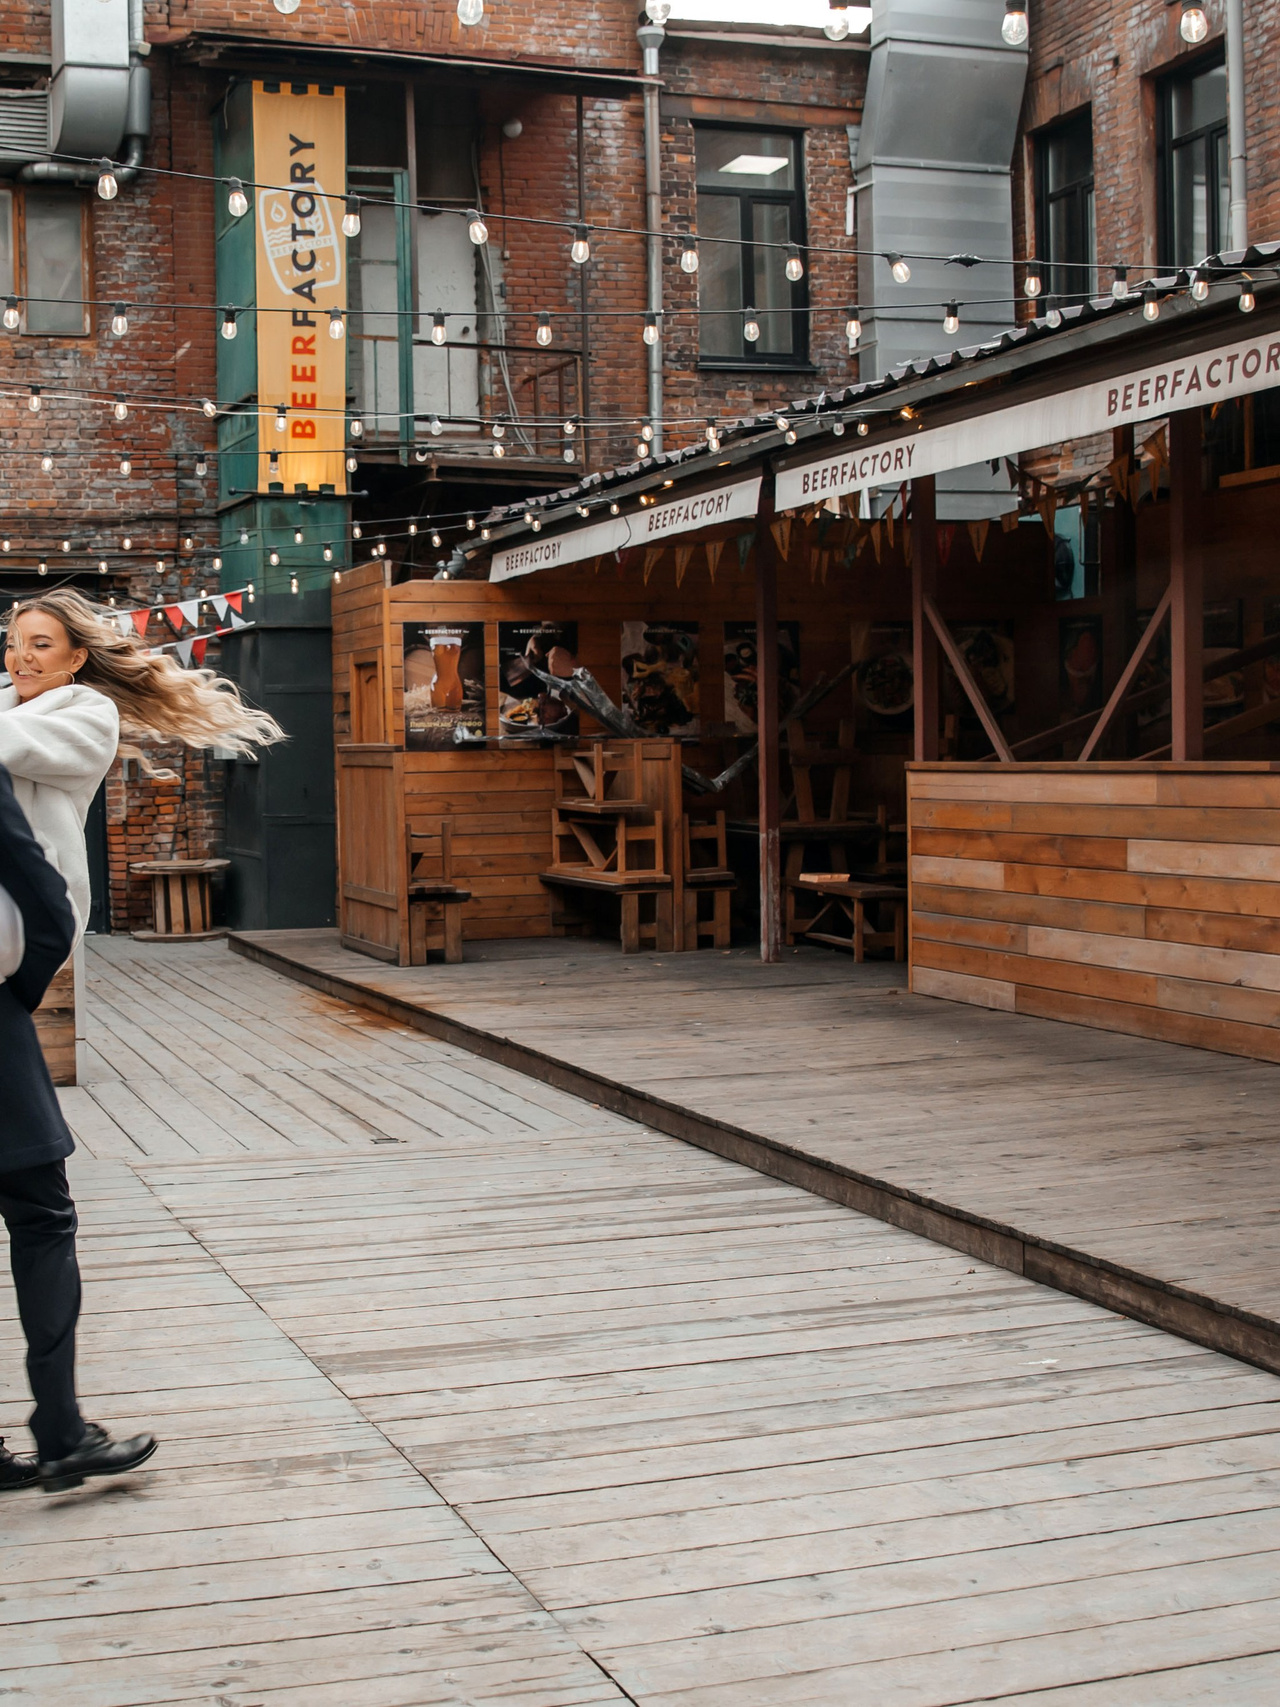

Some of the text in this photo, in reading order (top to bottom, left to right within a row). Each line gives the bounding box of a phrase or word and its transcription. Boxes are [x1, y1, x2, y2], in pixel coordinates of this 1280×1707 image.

[289, 133, 316, 439] BEERFACTORY
[802, 443, 916, 494] BEERFACTORY
[648, 491, 733, 532] BEERFACTORY
[506, 541, 562, 571] BEERFACTORY
